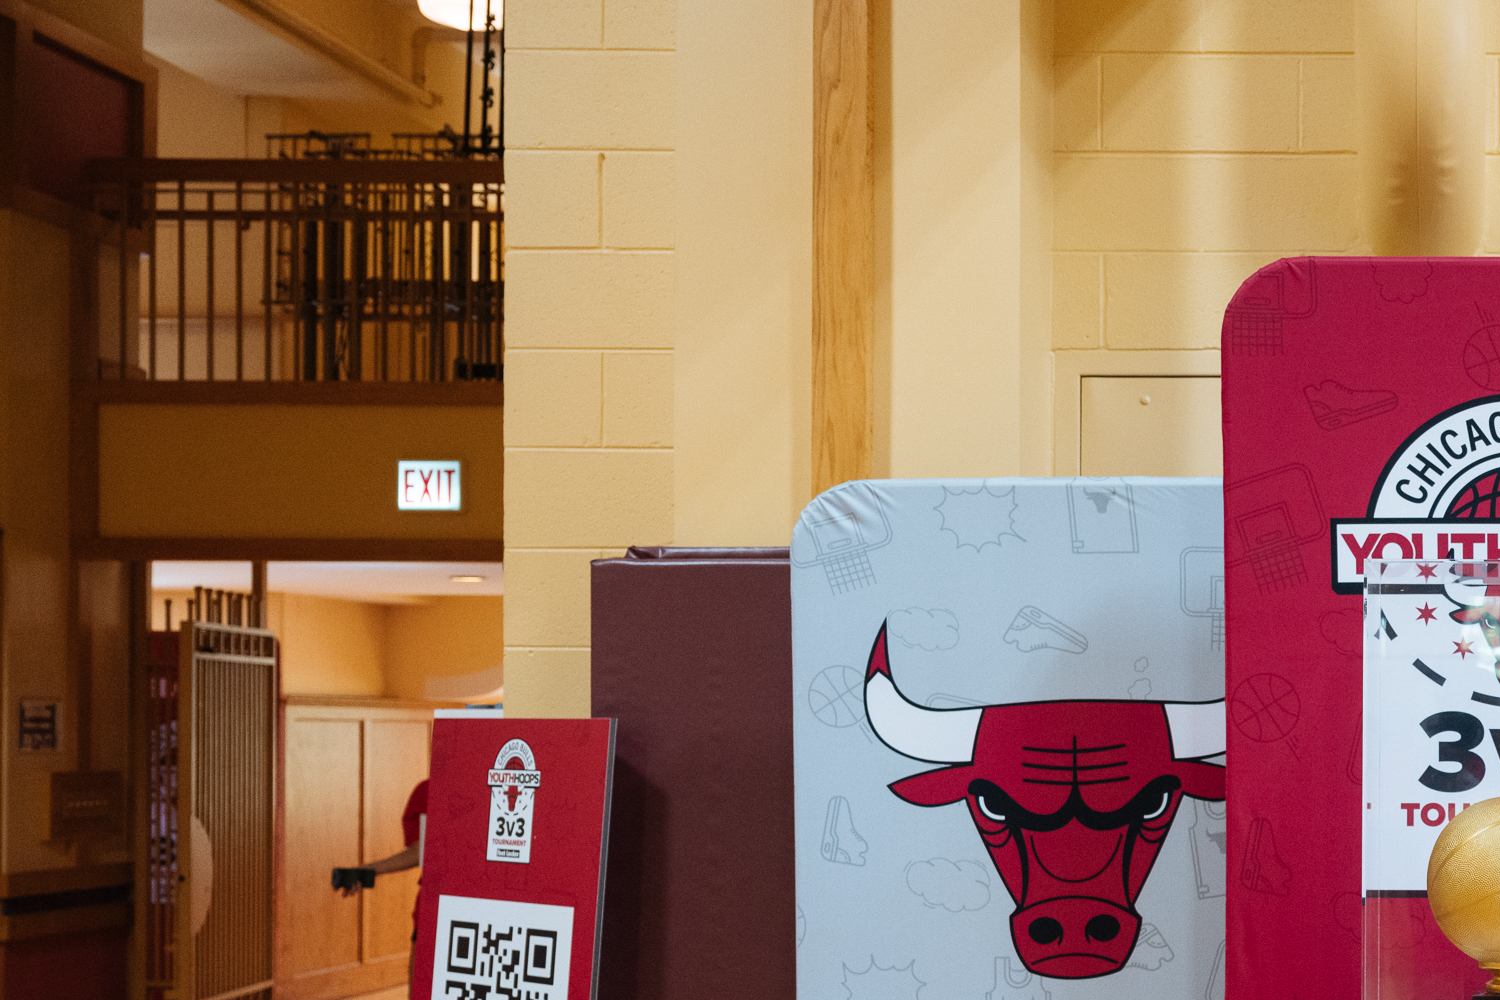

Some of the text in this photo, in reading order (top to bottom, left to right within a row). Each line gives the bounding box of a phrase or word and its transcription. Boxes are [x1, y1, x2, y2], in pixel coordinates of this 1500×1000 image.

[404, 469, 456, 503] EXIT
[497, 741, 533, 767] CHICAGO BULLS
[489, 772, 540, 784] YOUTHHOOPS
[495, 816, 526, 838] 3v3
